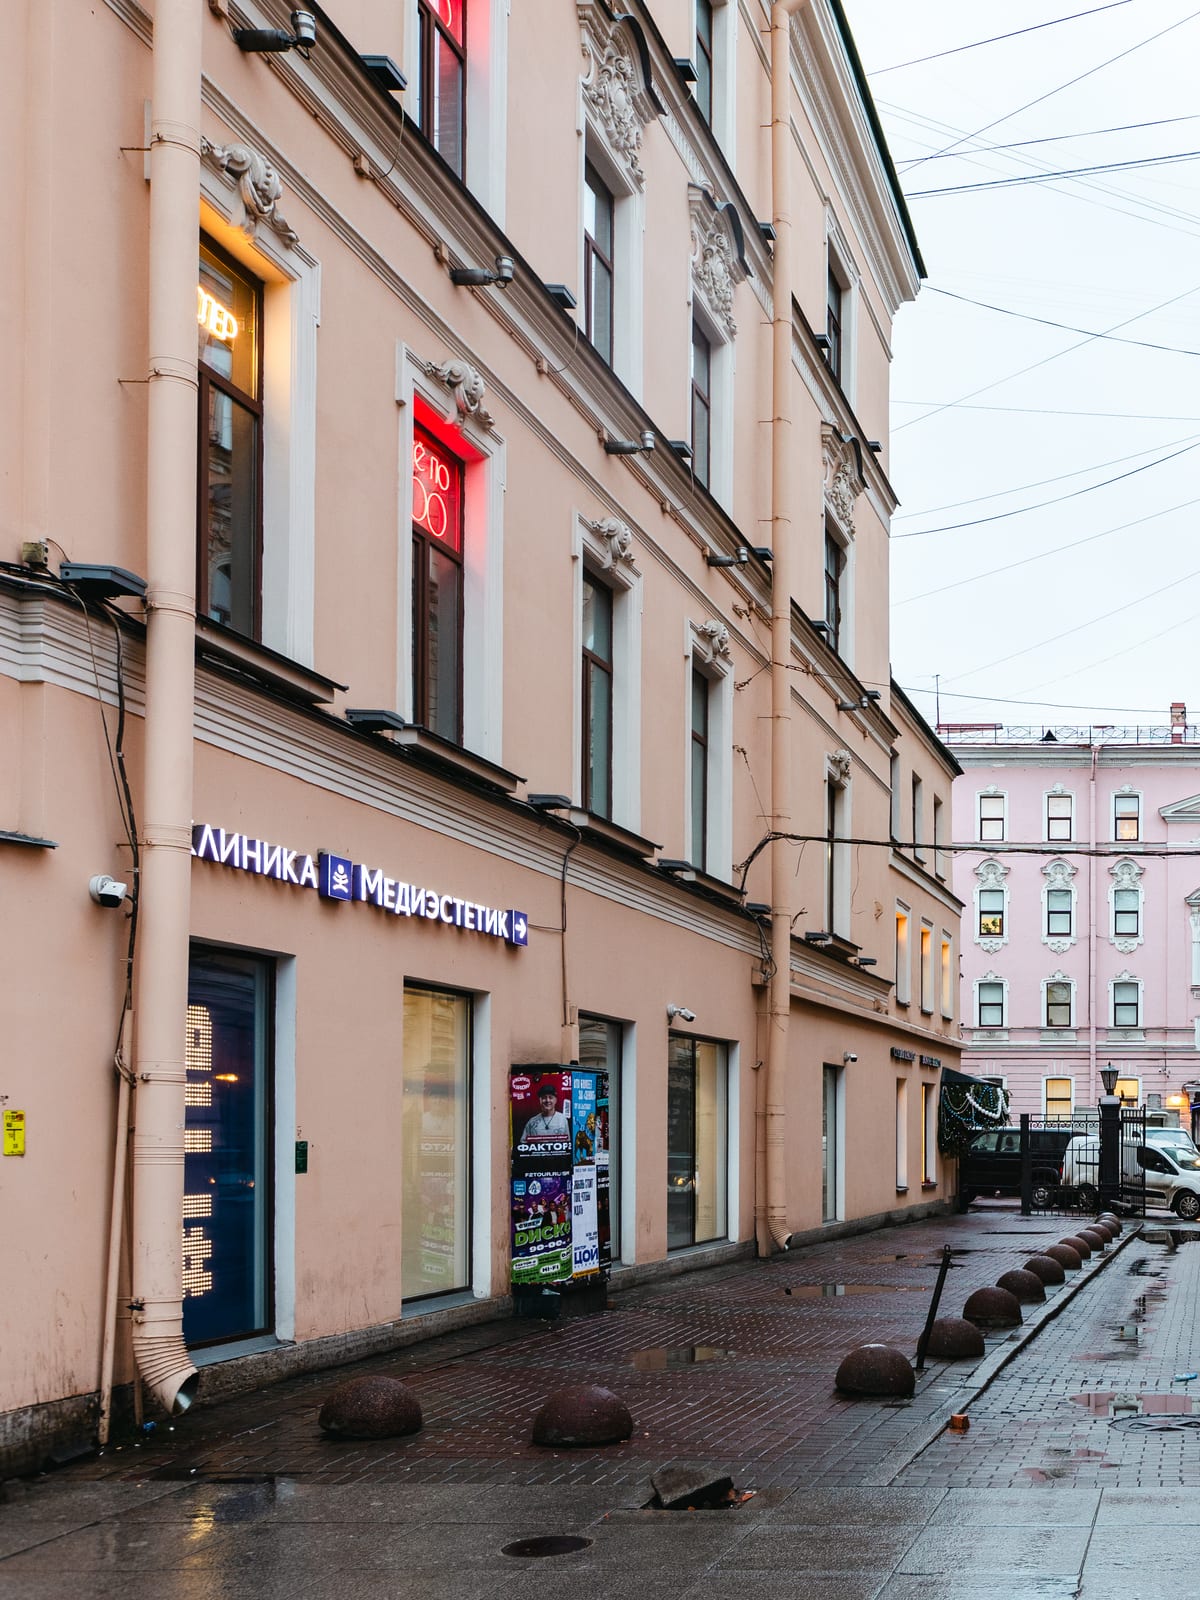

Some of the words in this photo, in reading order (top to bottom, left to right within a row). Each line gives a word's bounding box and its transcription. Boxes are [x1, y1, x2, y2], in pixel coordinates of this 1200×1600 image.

[430, 456, 449, 490] по
[190, 822, 318, 889] ЛИНИКА
[574, 1245, 599, 1264] ЦОЙ
